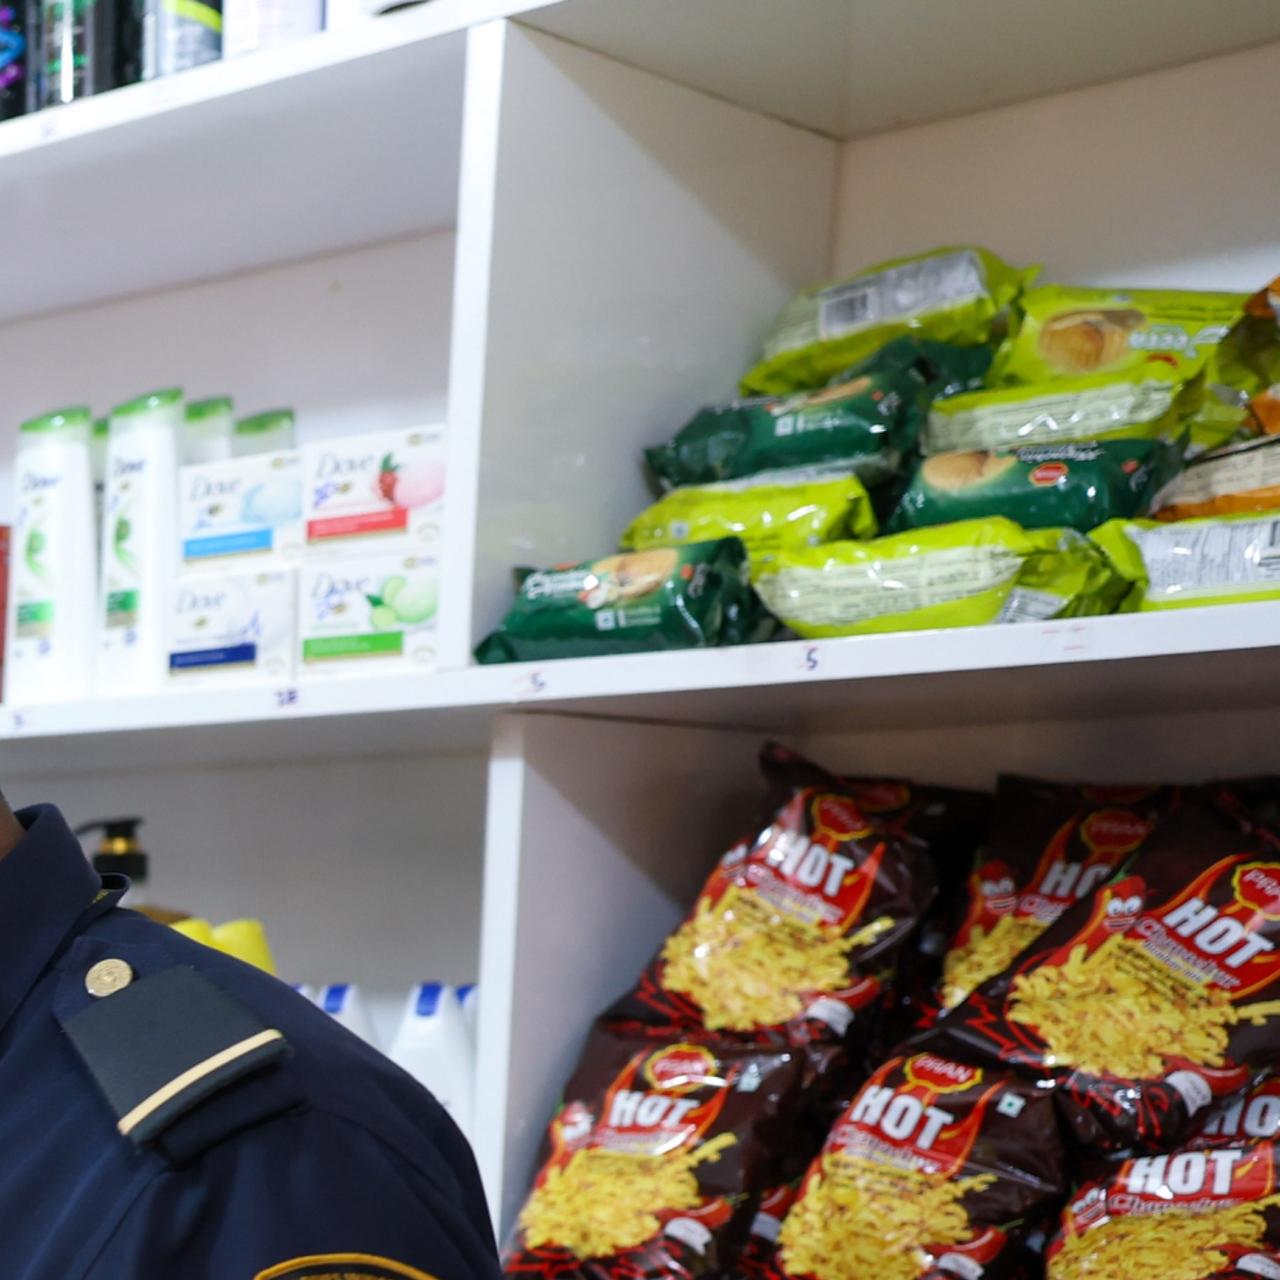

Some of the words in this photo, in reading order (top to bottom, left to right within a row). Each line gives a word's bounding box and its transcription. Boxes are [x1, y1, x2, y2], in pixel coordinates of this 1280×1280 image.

[317, 453, 374, 480] Dove
[192, 475, 240, 500] Dove
[176, 589, 226, 615] Dove
[312, 573, 369, 600] Dove
[766, 829, 855, 897] HOT
[1162, 895, 1275, 969] HOT
[913, 1054, 973, 1083] PRAN
[608, 1088, 701, 1128] HOT
[849, 1083, 955, 1151] HOT
[1202, 1094, 1280, 1138] HO
[1126, 1149, 1243, 1198] HOT
